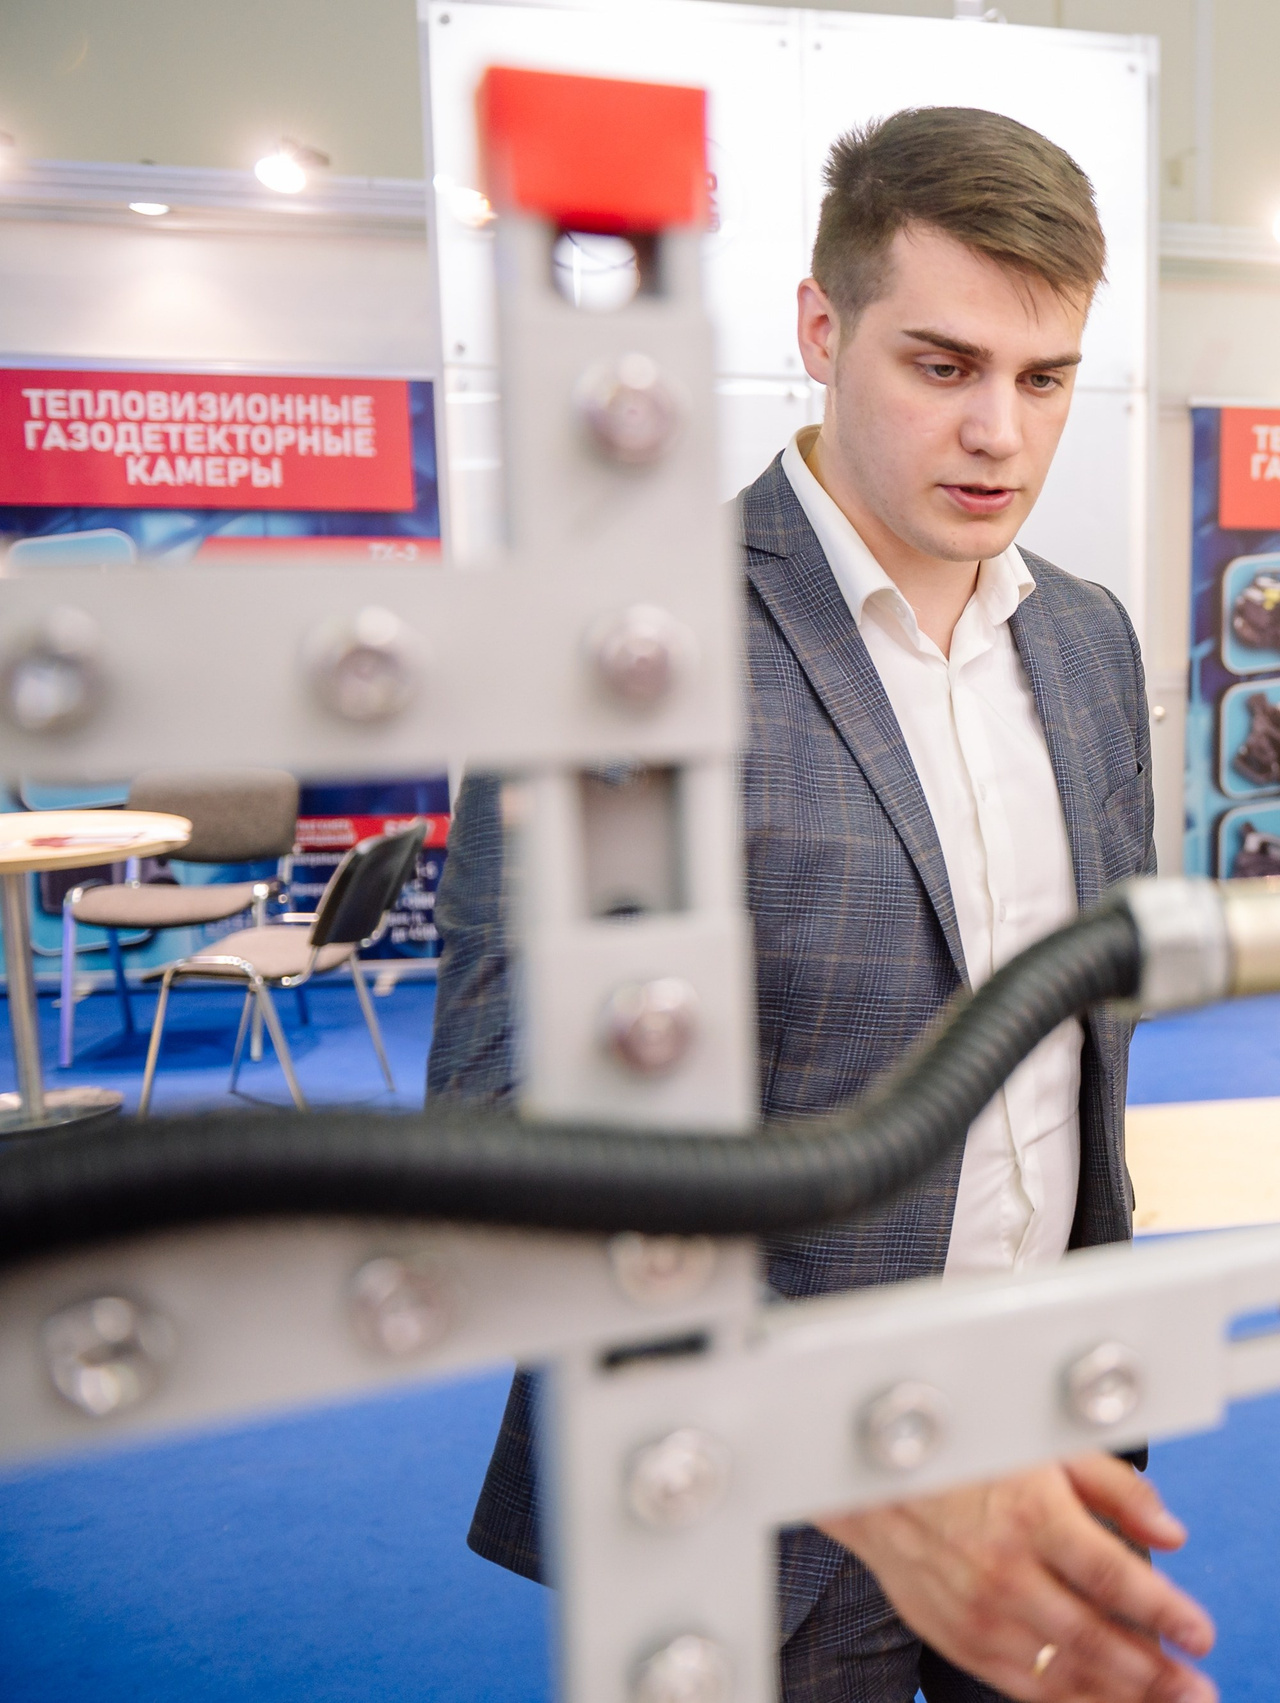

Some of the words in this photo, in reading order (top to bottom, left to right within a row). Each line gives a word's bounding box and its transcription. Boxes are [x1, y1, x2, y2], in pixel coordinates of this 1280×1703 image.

[22, 388, 375, 427] ТЕПЛОВИЗИОННЫЕ
[23, 420, 377, 458] ГАЗОДЕТЕКТОРНЫЕ
[126, 455, 283, 488] КАМЕРЫ
